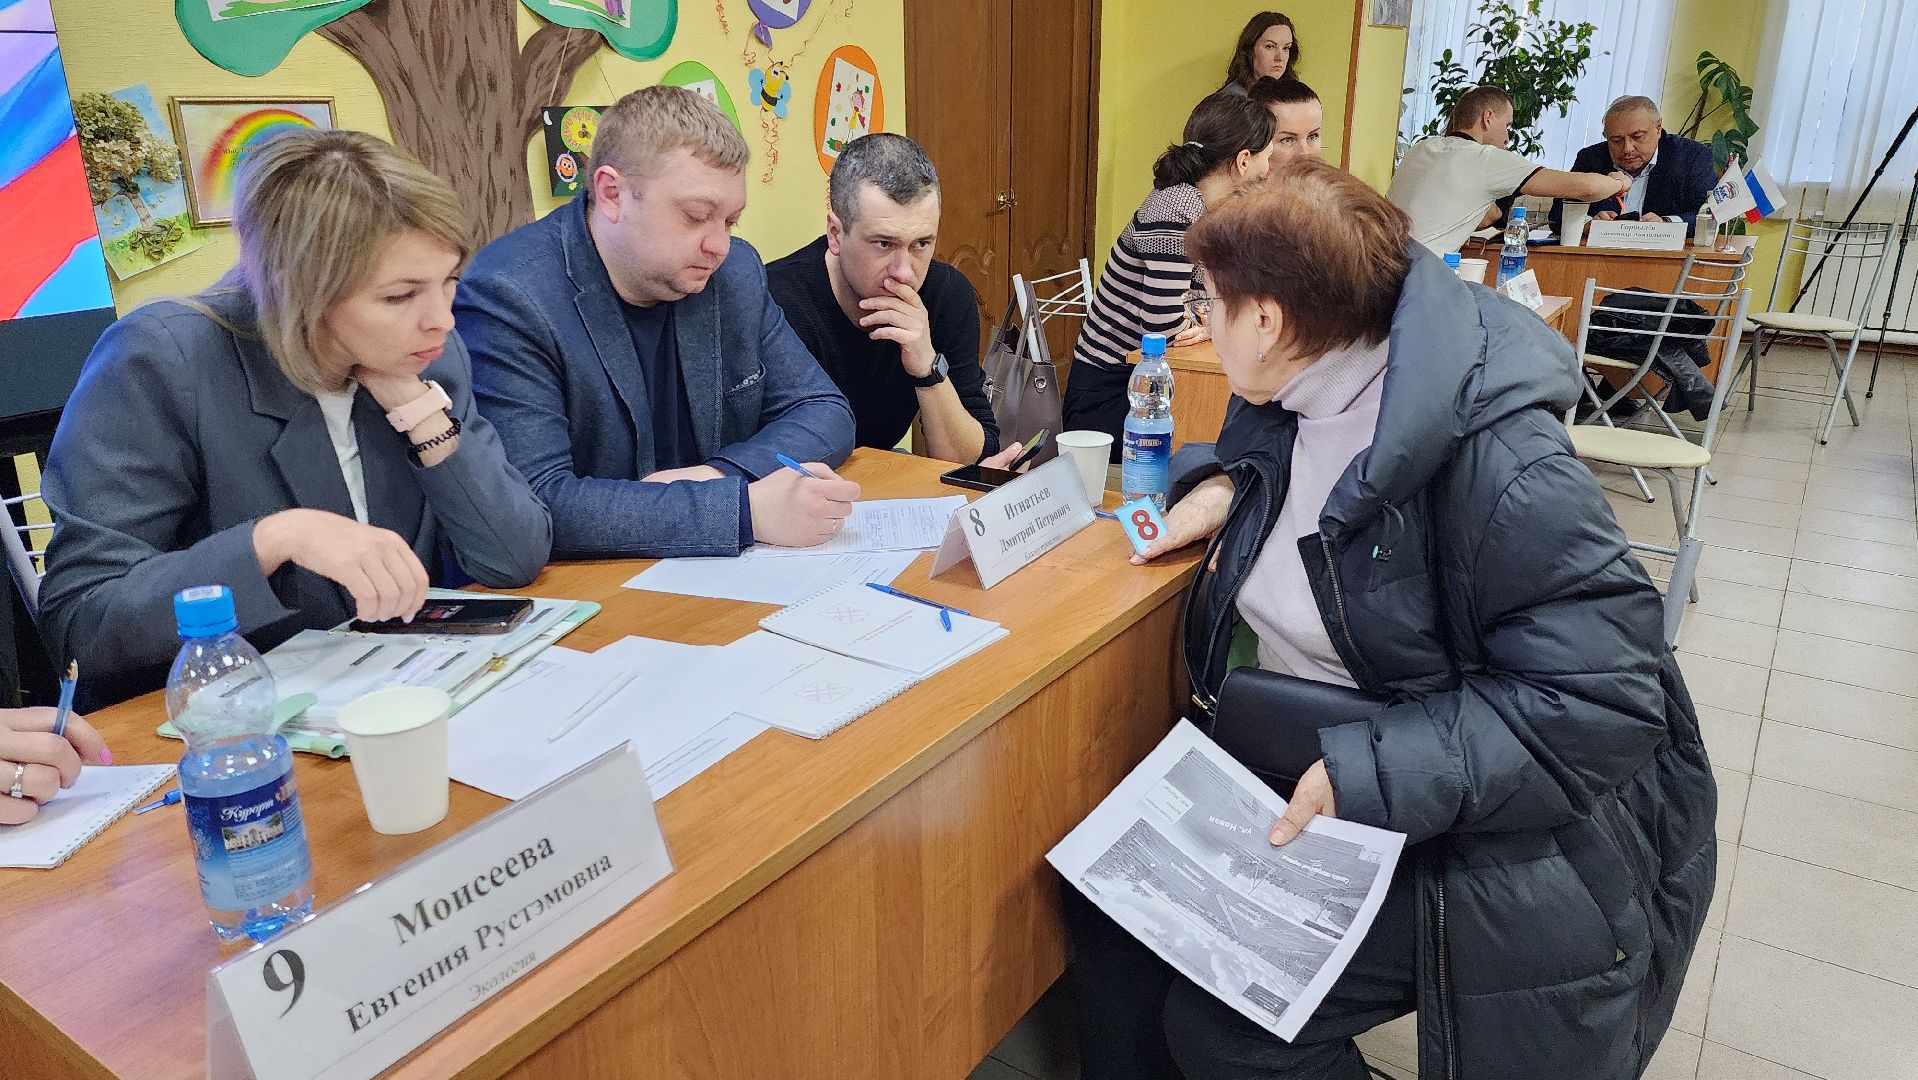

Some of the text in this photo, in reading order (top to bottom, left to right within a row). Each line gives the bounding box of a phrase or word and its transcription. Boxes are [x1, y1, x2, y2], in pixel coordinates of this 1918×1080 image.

[969, 508, 986, 537] 8
[999, 521, 1036, 555] Дмитрий
[1036, 503, 1071, 532] Петрович
[1004, 487, 1051, 521] Игнатьев
[1131, 509, 1159, 541] 8
[391, 833, 556, 947] Моисеева
[345, 853, 614, 1035] Евгения Рустэмовна
[262, 948, 307, 1021] 9
